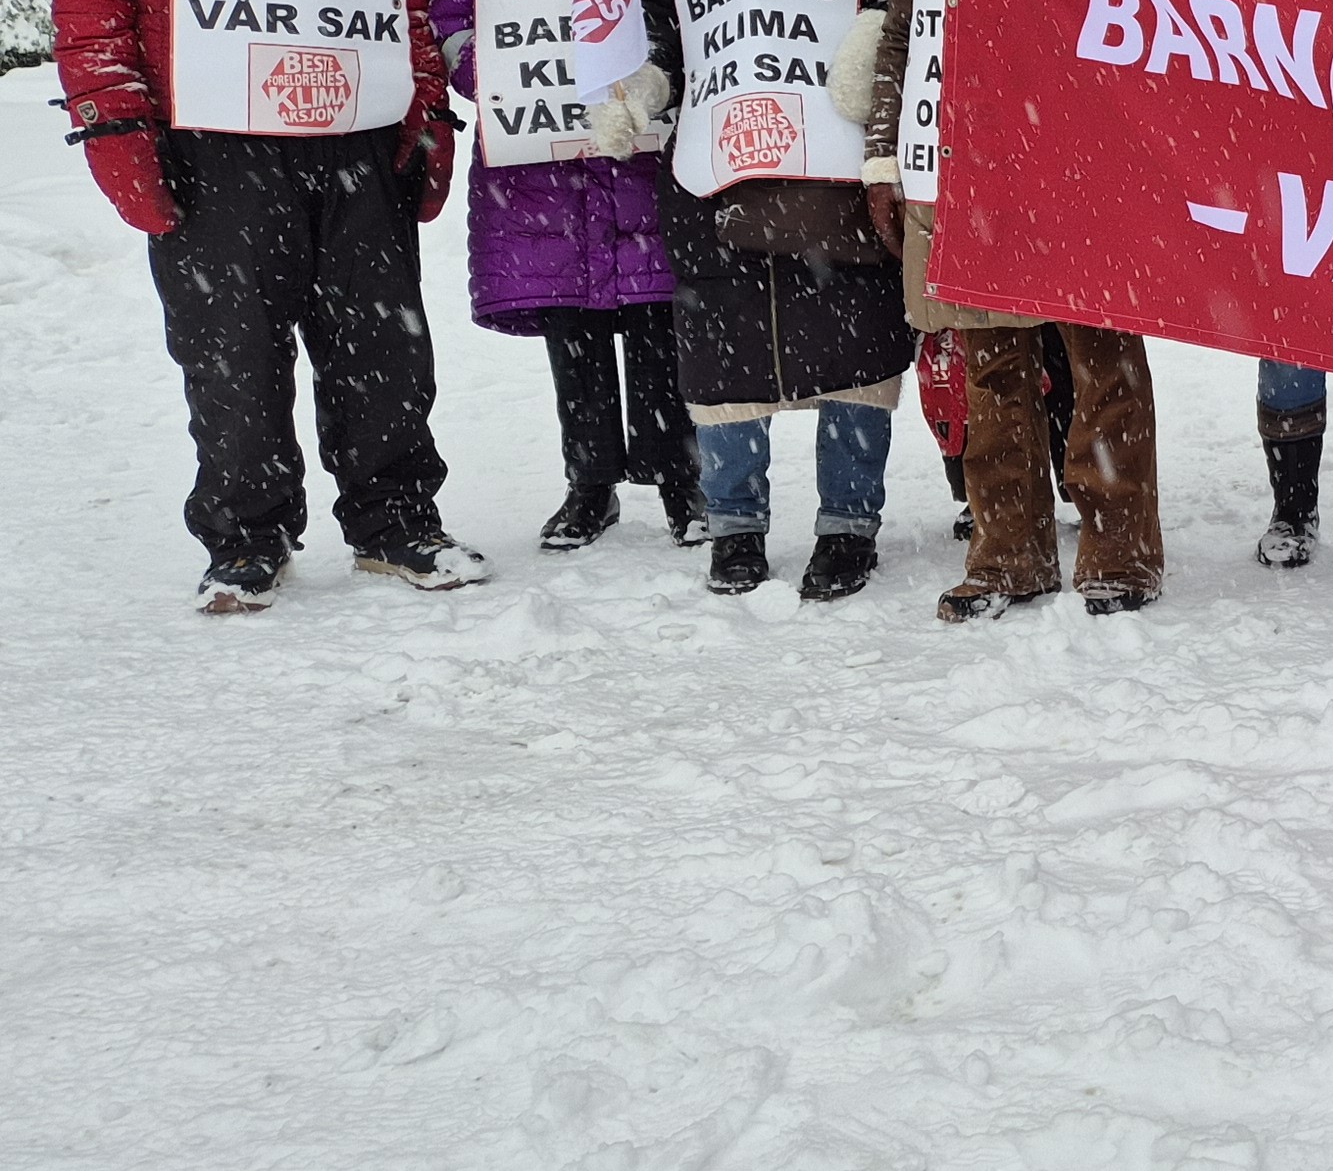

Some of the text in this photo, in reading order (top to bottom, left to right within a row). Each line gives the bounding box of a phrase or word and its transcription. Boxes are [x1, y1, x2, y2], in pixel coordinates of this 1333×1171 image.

[317, 6, 402, 44] SAK
[703, 8, 820, 61] KLIMA
[282, 52, 334, 74] BESTE
[267, 70, 346, 87] FORELDRENES
[268, 86, 348, 110] KLIMA
[279, 106, 339, 124] AKSJON
[491, 98, 593, 136] VÅR
[729, 100, 774, 125] BESTE
[721, 128, 794, 158] KLIMA
[729, 147, 787, 170] AKSJON
